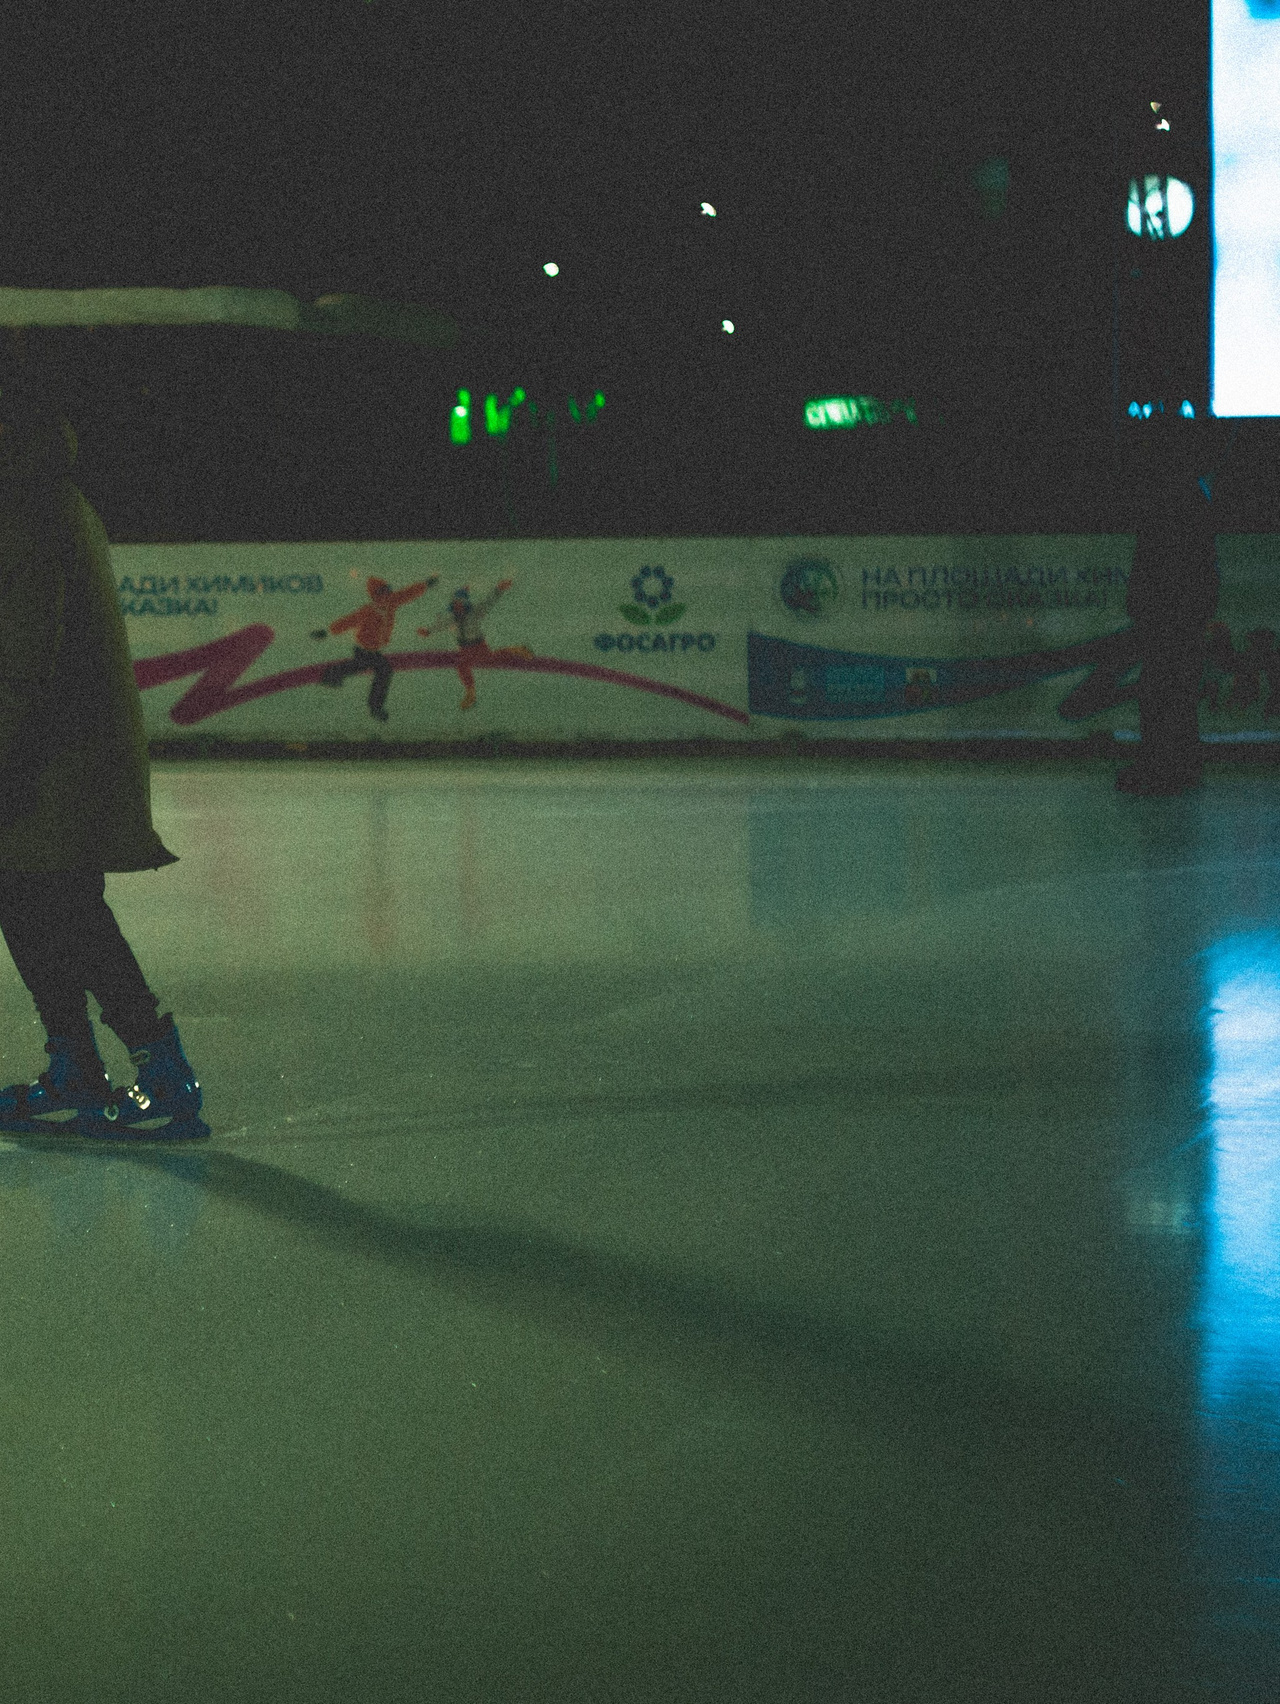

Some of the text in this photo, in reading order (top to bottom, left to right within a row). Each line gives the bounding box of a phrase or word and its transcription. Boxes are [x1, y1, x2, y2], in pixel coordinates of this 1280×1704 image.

[187, 574, 323, 594] ХИМИКОВ
[862, 566, 901, 586] НА
[121, 597, 217, 616] КАЗКА!
[593, 632, 716, 652] ФОСАГРО
